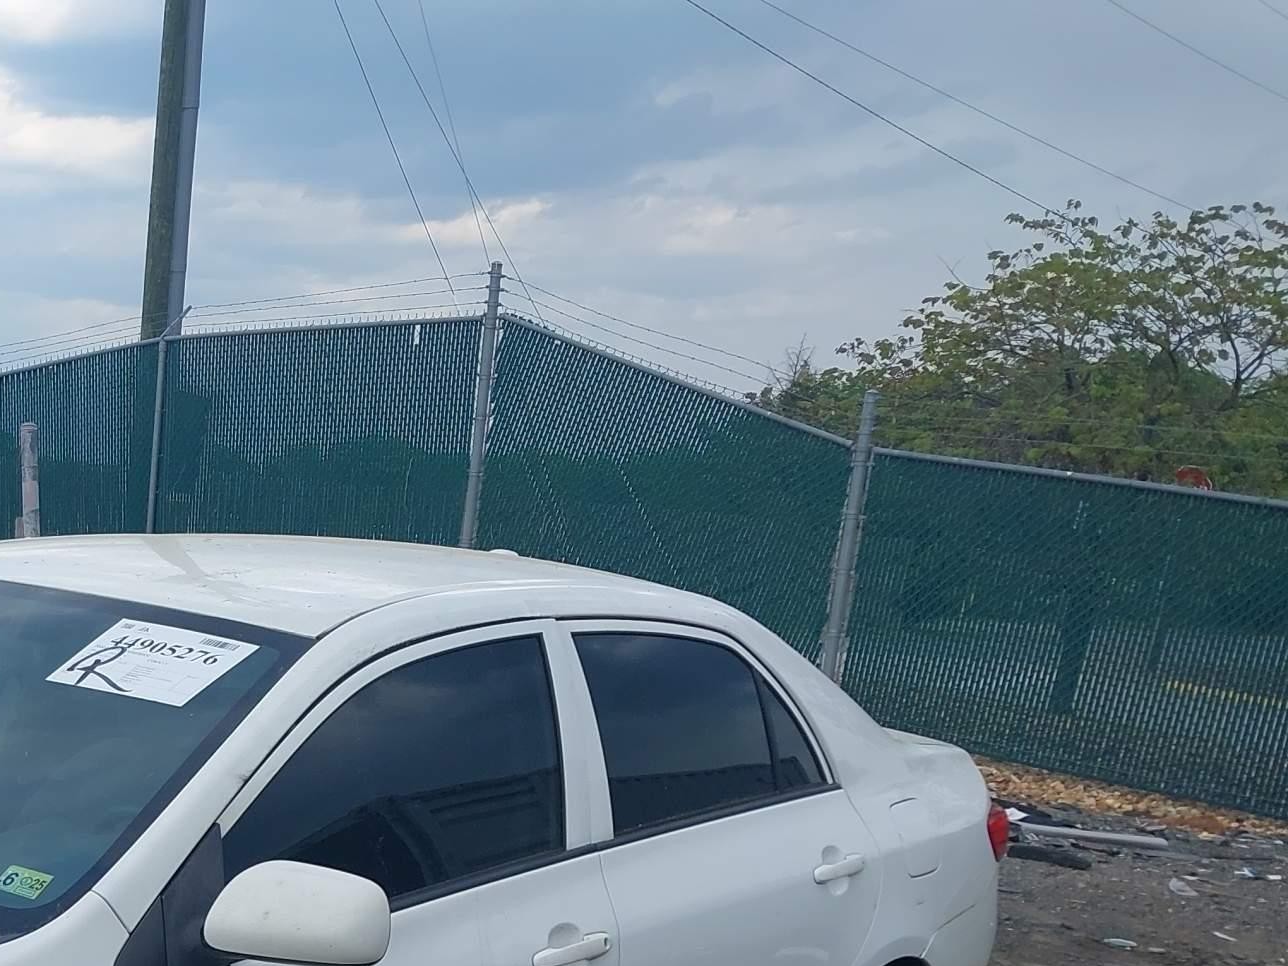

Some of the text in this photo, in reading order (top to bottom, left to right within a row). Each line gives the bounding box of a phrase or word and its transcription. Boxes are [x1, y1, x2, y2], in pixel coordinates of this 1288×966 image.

[111, 635, 222, 665] 44905276
[2, 872, 47, 891] 6 25
